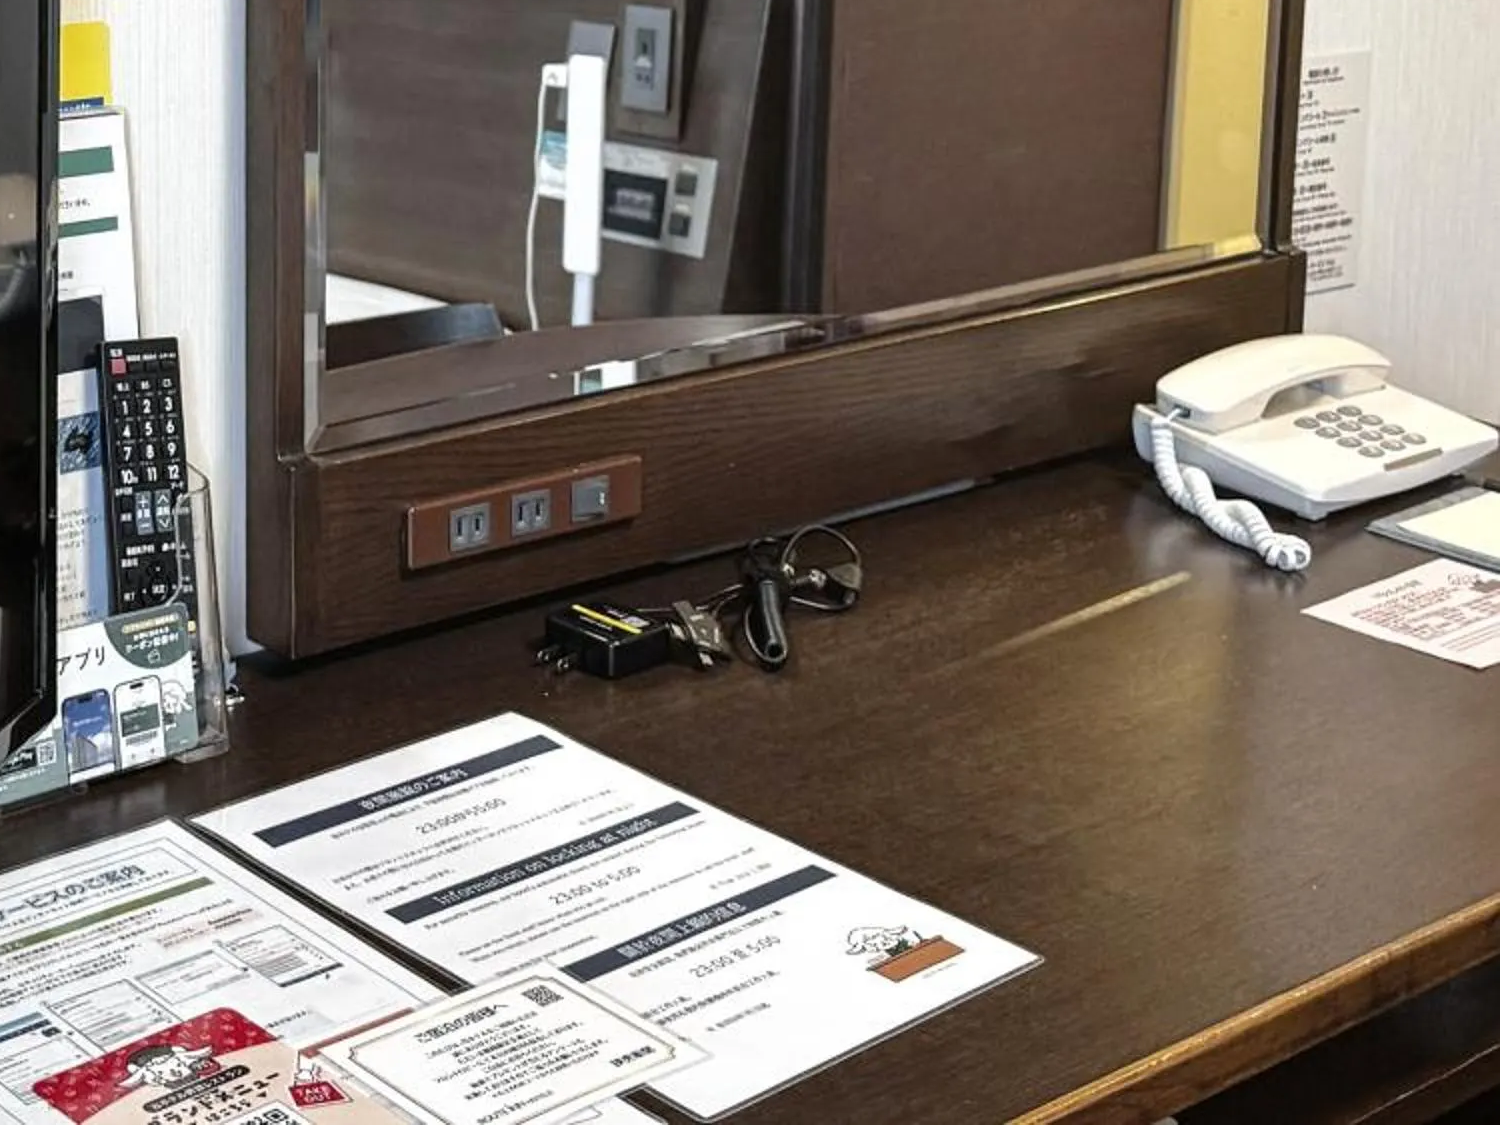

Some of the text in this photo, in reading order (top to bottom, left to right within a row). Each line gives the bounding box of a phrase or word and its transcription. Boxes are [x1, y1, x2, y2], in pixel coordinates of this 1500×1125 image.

[122, 400, 128, 415] 1
[142, 398, 151, 414] 2
[164, 396, 173, 412] 3
[122, 424, 131, 438] 4
[145, 421, 153, 436] 5
[166, 419, 175, 434] 6
[123, 446, 132, 462] 7
[146, 444, 155, 459] 8
[167, 442, 176, 456] 9
[147, 466, 157, 482] 11
[167, 464, 180, 480] 12
[432, 868, 526, 905] Information
[524, 860, 547, 873] on
[546, 840, 601, 866] locking
[599, 832, 615, 845] at
[616, 818, 658, 839] night
[549, 884, 592, 905] 23:00
[607, 866, 641, 883] 5:00
[689, 955, 734, 978] 23:00
[746, 935, 781, 954] 5:00
